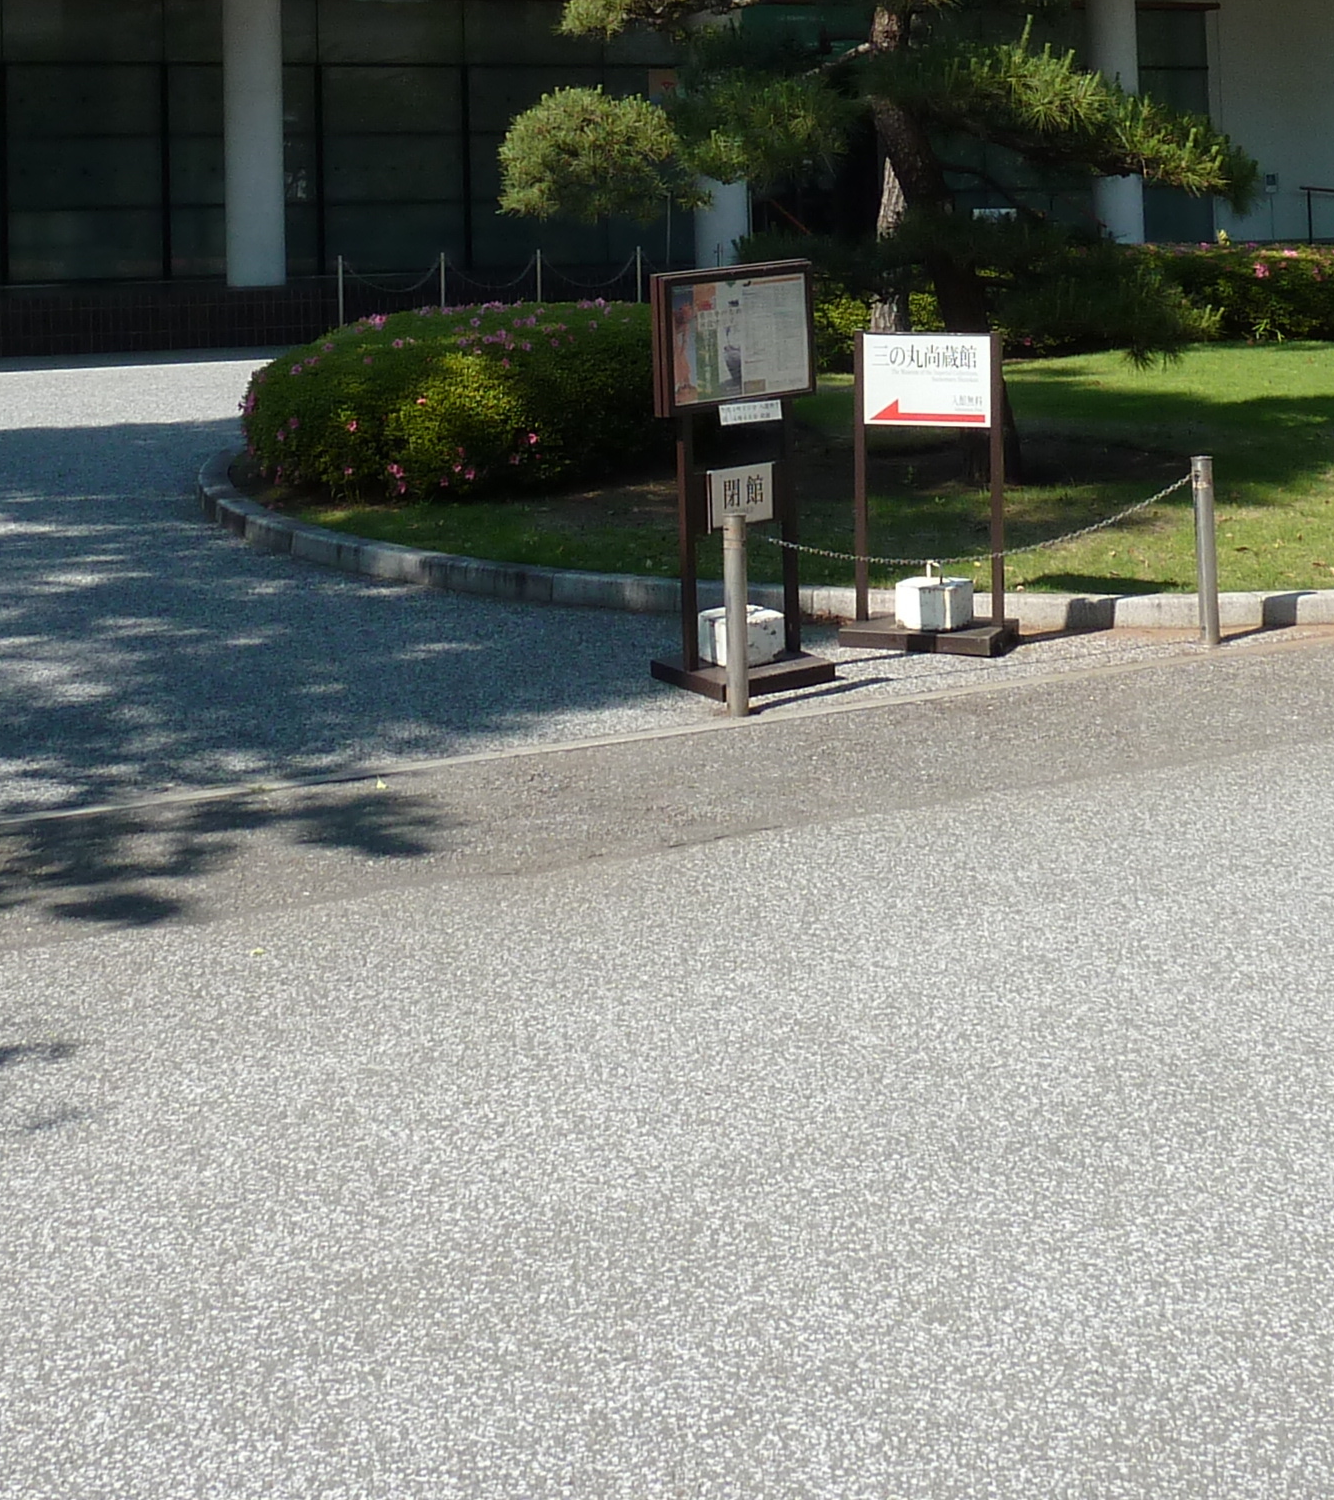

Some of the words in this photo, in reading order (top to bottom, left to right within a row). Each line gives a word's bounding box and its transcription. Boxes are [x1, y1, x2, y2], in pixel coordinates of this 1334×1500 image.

[871, 344, 977, 369] 三の丸尚蔵館
[723, 474, 763, 510] 閉館
